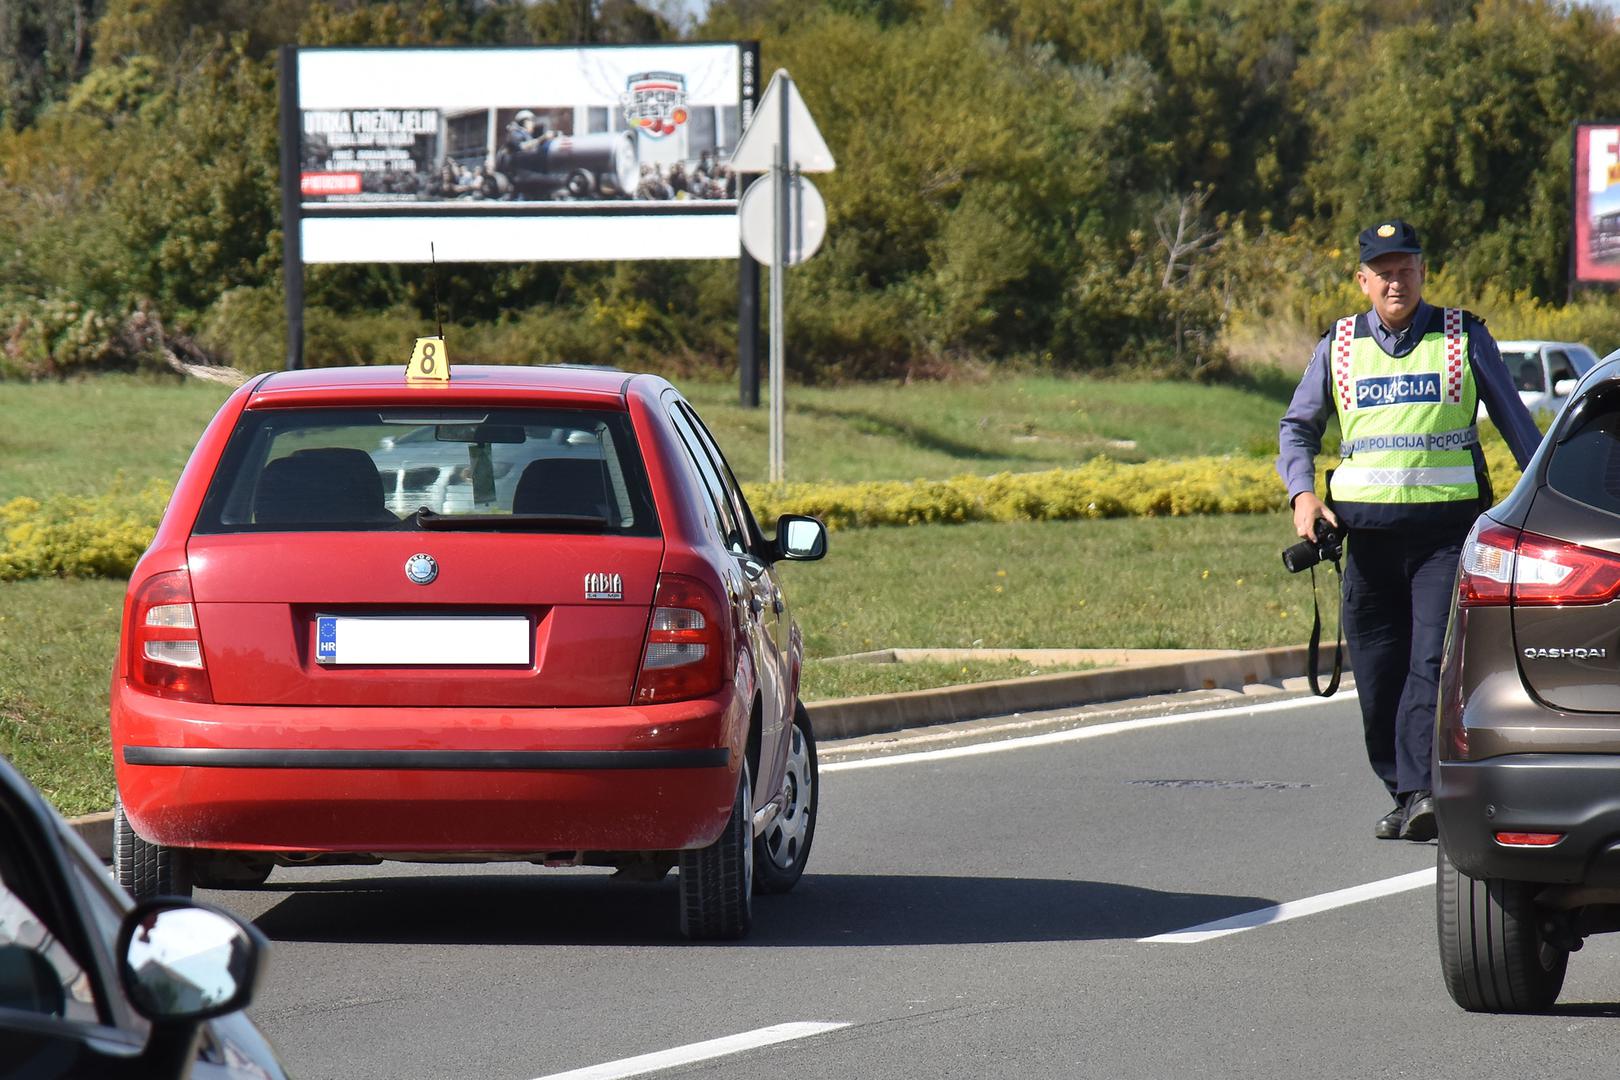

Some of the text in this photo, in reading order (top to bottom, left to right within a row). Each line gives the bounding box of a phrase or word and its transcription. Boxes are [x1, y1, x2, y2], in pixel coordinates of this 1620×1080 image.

[420, 342, 436, 374] 8
[1359, 380, 1437, 402] POLICIJA
[1369, 436, 1425, 449] POLICIJA
[585, 572, 622, 593] FABIA
[320, 641, 336, 652] HR
[1523, 647, 1606, 660] QASHQAI
